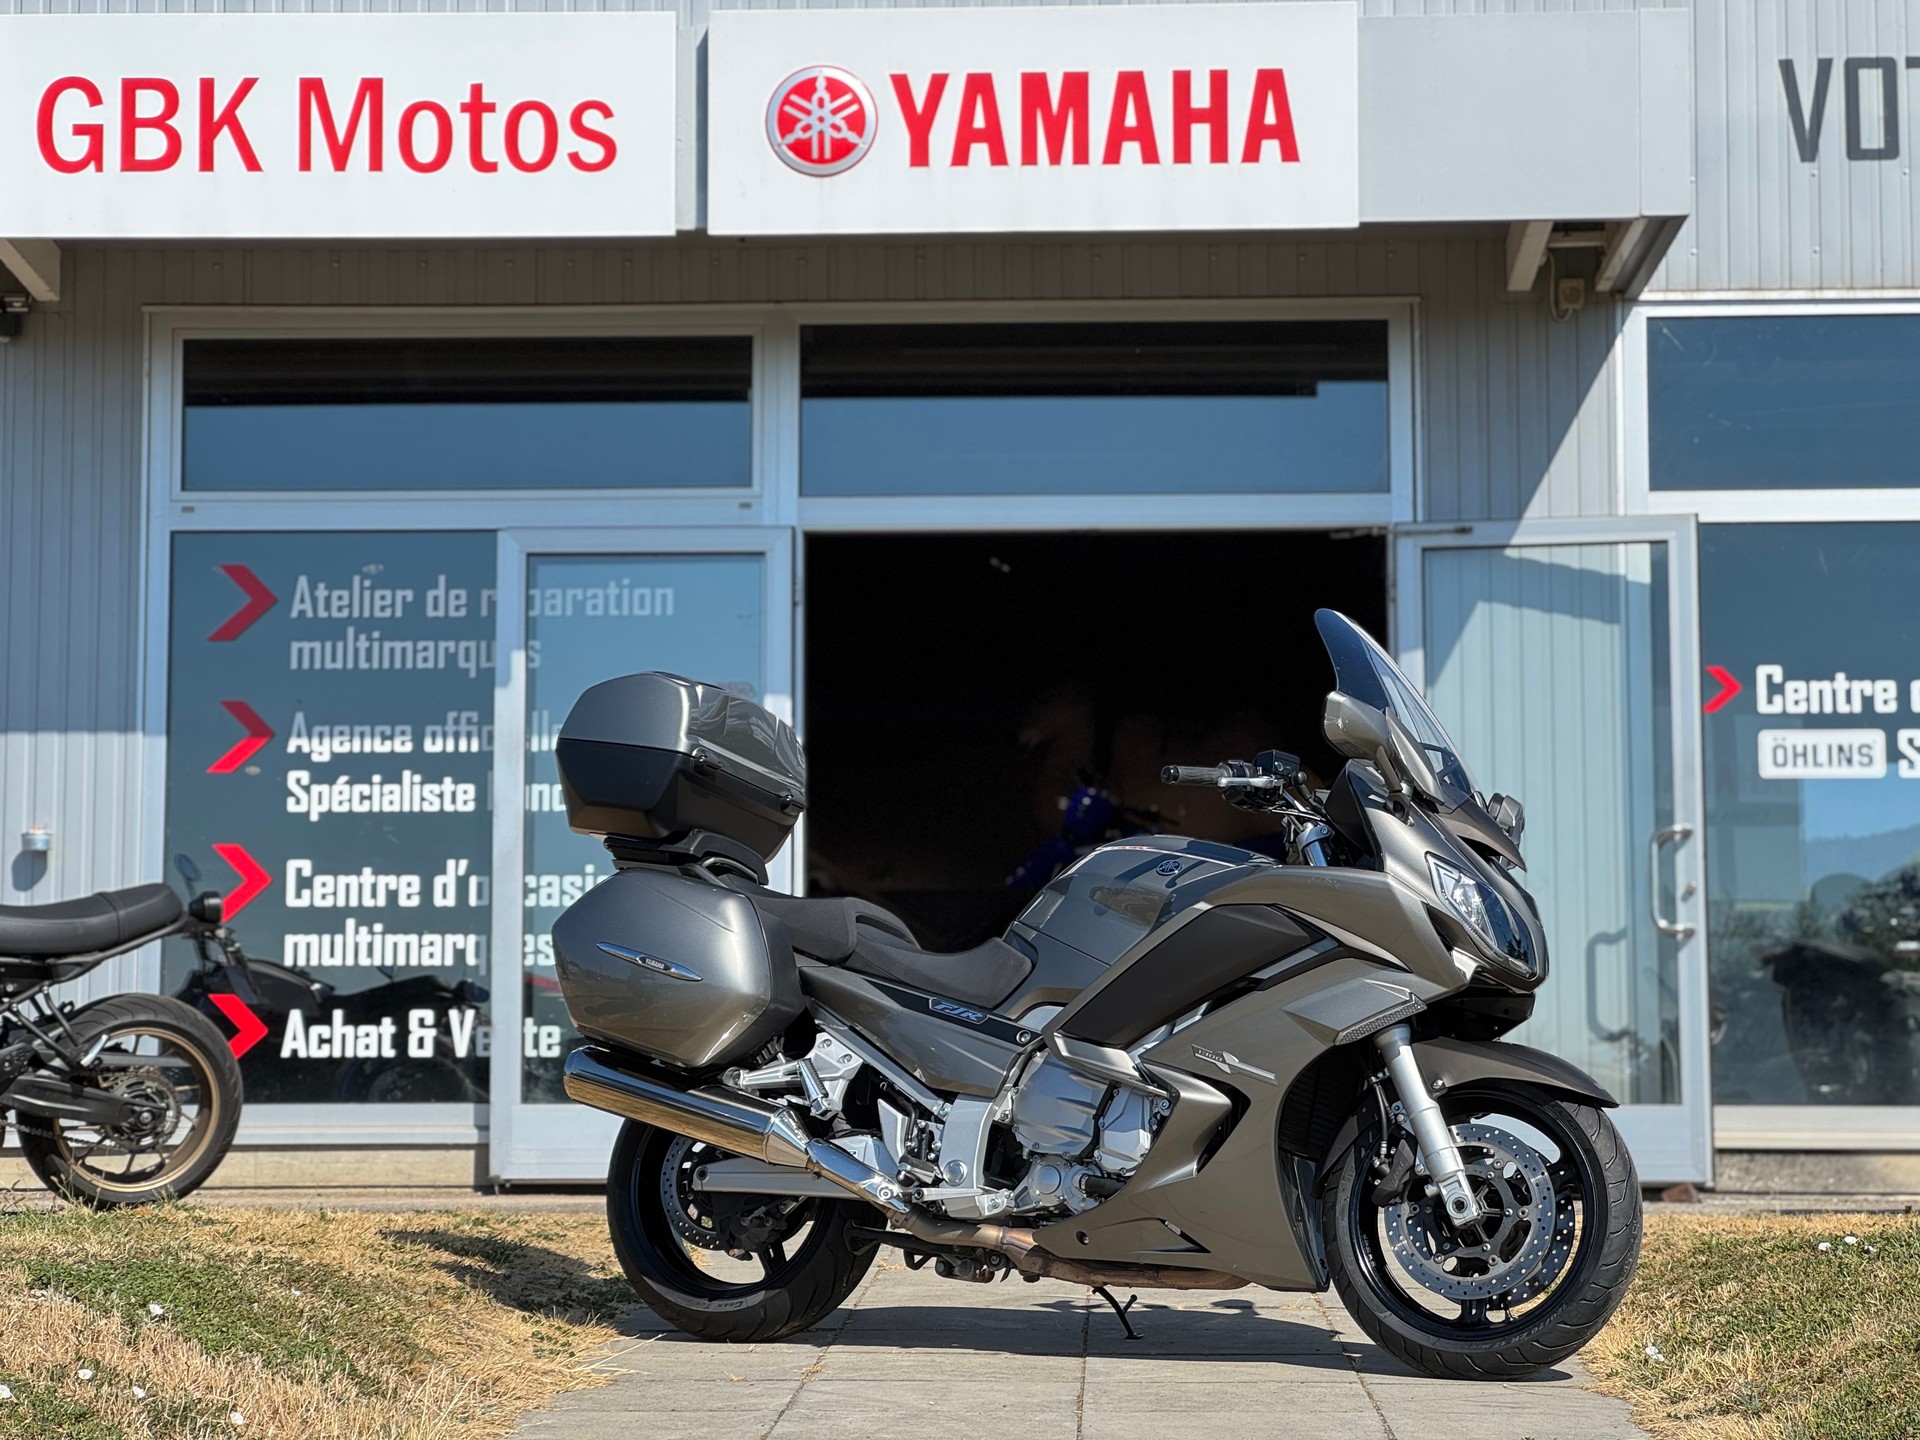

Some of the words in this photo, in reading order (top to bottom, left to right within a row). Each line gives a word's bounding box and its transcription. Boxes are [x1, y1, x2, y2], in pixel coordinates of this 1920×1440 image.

[37, 77, 262, 173] GBK
[299, 78, 617, 173] Motos
[890, 69, 1300, 167] YAMAHA
[290, 574, 414, 618] Atelier
[426, 574, 467, 617] de
[290, 626, 541, 679] multimarqus
[1756, 664, 1898, 714] Centre
[287, 711, 413, 762] Agence
[1772, 737, 1874, 768] ÖHLINS
[287, 770, 476, 822] Spécialiste
[286, 859, 421, 907] Centre
[284, 918, 556, 976] multimarqes
[645, 957, 665, 970] YAMAHA
[281, 1009, 396, 1058] Achat
[408, 1009, 437, 1058] &
[448, 1009, 561, 1058] Vete
[933, 1001, 983, 1021] FJR
